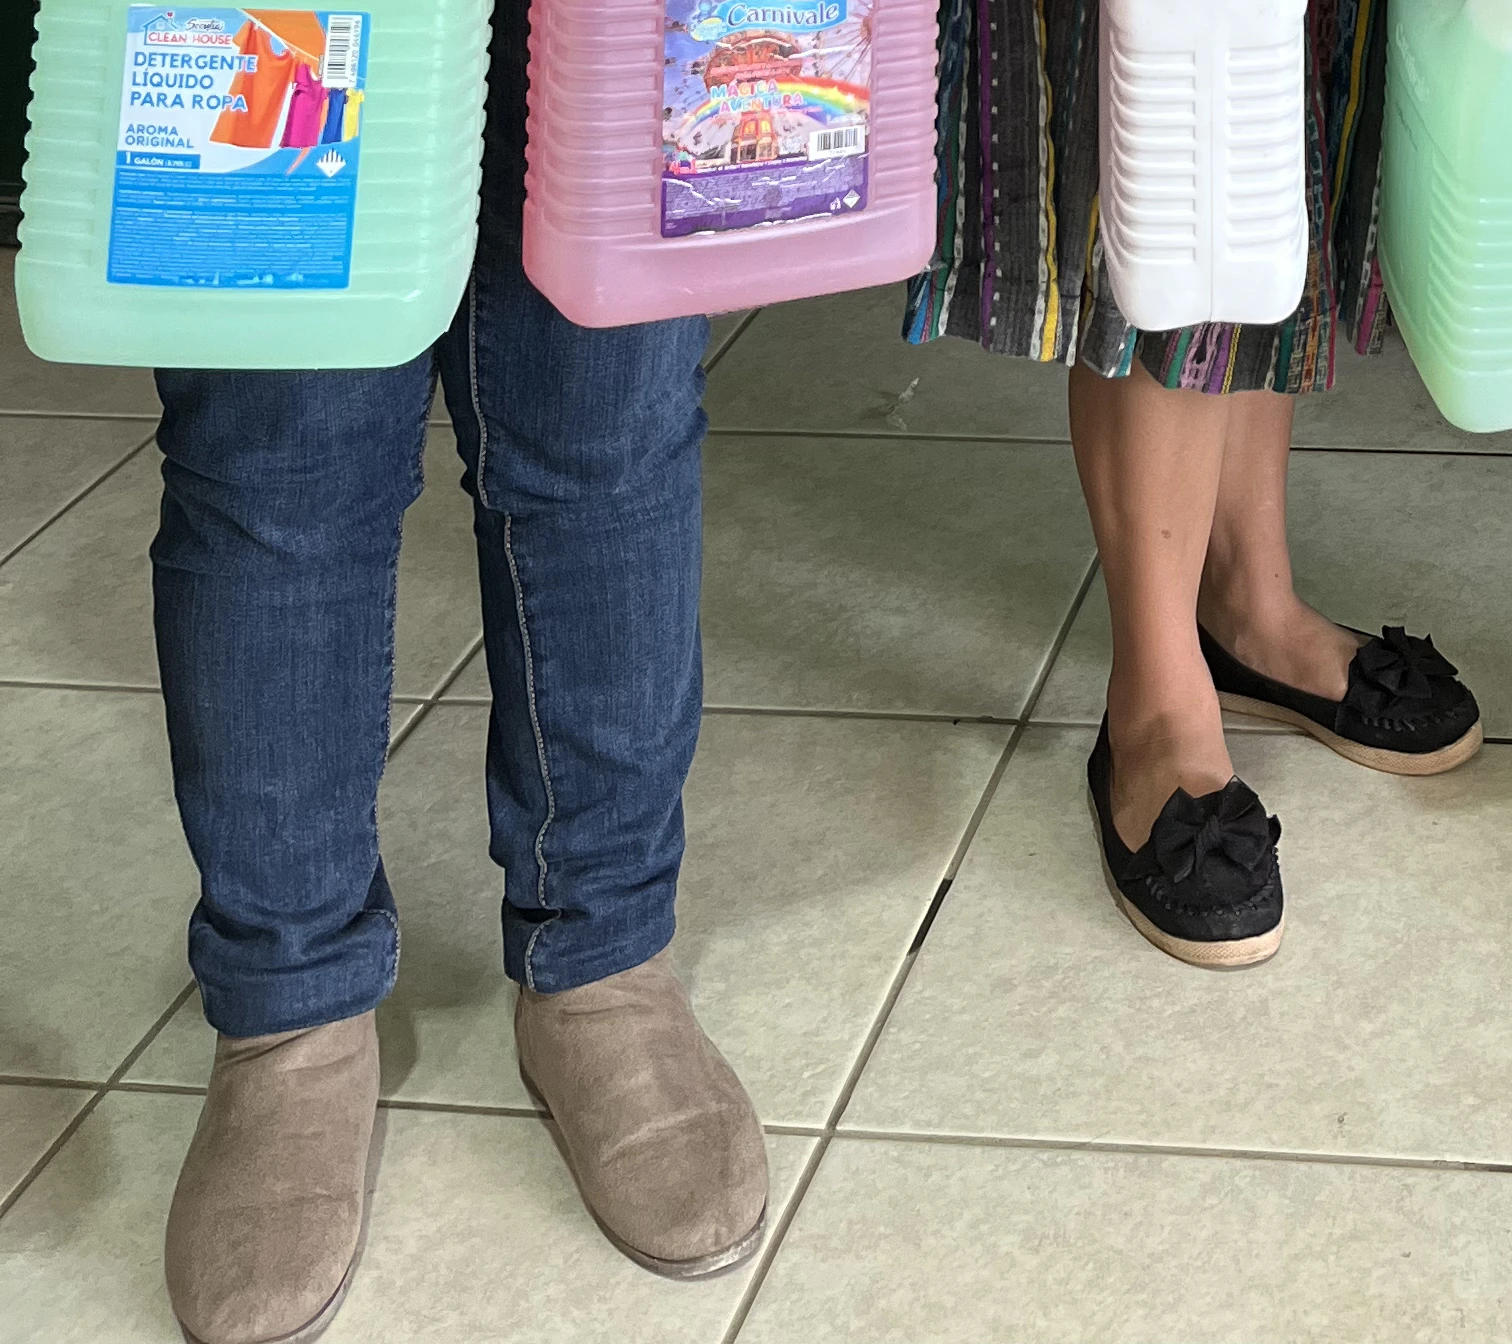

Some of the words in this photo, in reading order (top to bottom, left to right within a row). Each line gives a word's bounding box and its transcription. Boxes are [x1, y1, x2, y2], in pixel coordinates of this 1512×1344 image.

[727, 1, 839, 27] Carnivale
[148, 32, 187, 43] CLEAN
[193, 34, 232, 45] HOUSE
[134, 51, 256, 71] DETERGENTE
[132, 68, 214, 91] LÍQUIDO
[130, 91, 185, 109] PARA
[192, 94, 247, 110] ROPA
[720, 93, 804, 112] AVENTURA
[126, 124, 178, 136] AROMA
[125, 135, 194, 148] ORIGINAL
[134, 156, 164, 166] GALÓN
